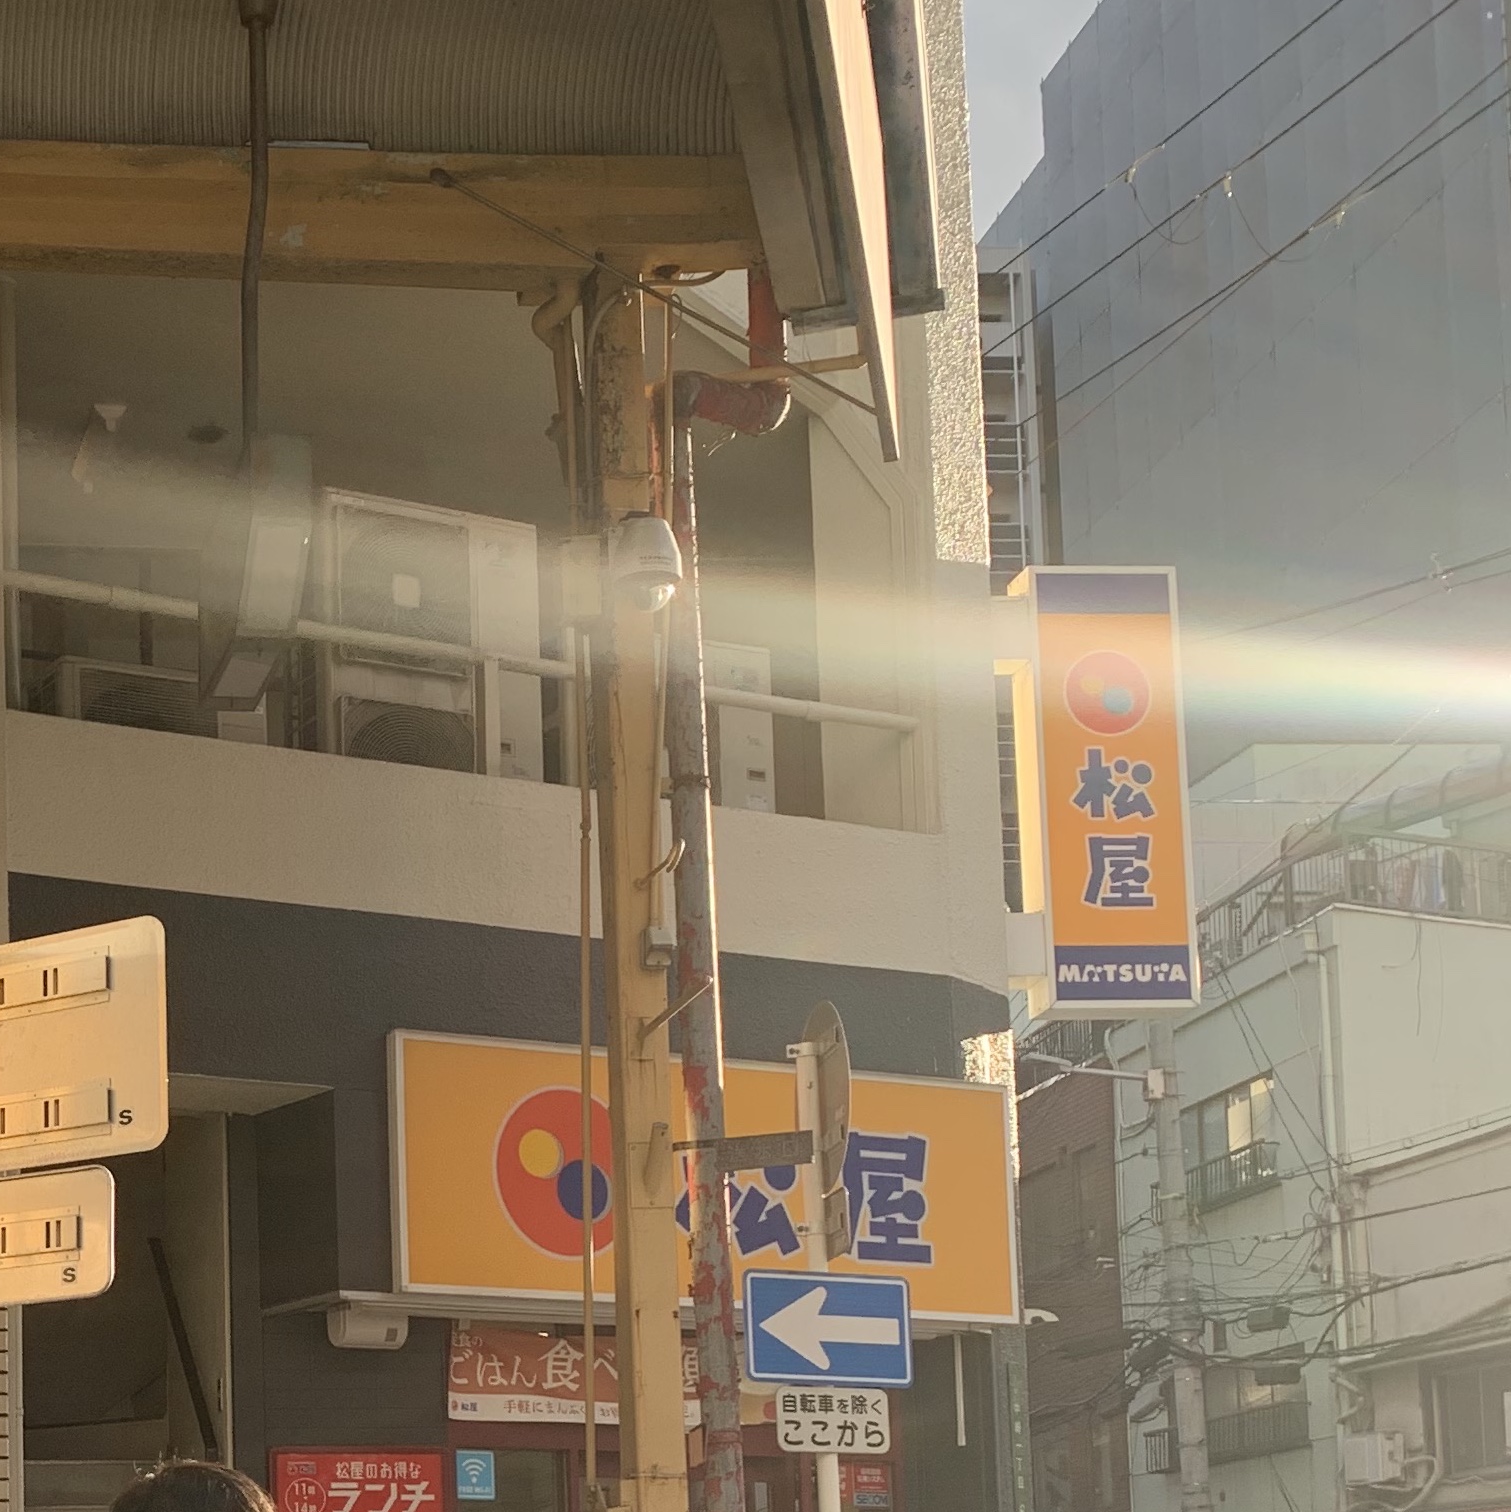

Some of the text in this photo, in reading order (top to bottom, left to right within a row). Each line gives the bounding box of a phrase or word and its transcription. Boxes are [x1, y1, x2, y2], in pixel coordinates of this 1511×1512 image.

[1070, 747, 1156, 907] 松屋
[1058, 962, 1187, 984] MATSUYA
[118, 1109, 133, 1126] S
[61, 1267, 76, 1283] S
[782, 1393, 883, 1415] 自転車を除く
[783, 1419, 886, 1448] ここから
[335, 1460, 422, 1480] 松屋のお得な
